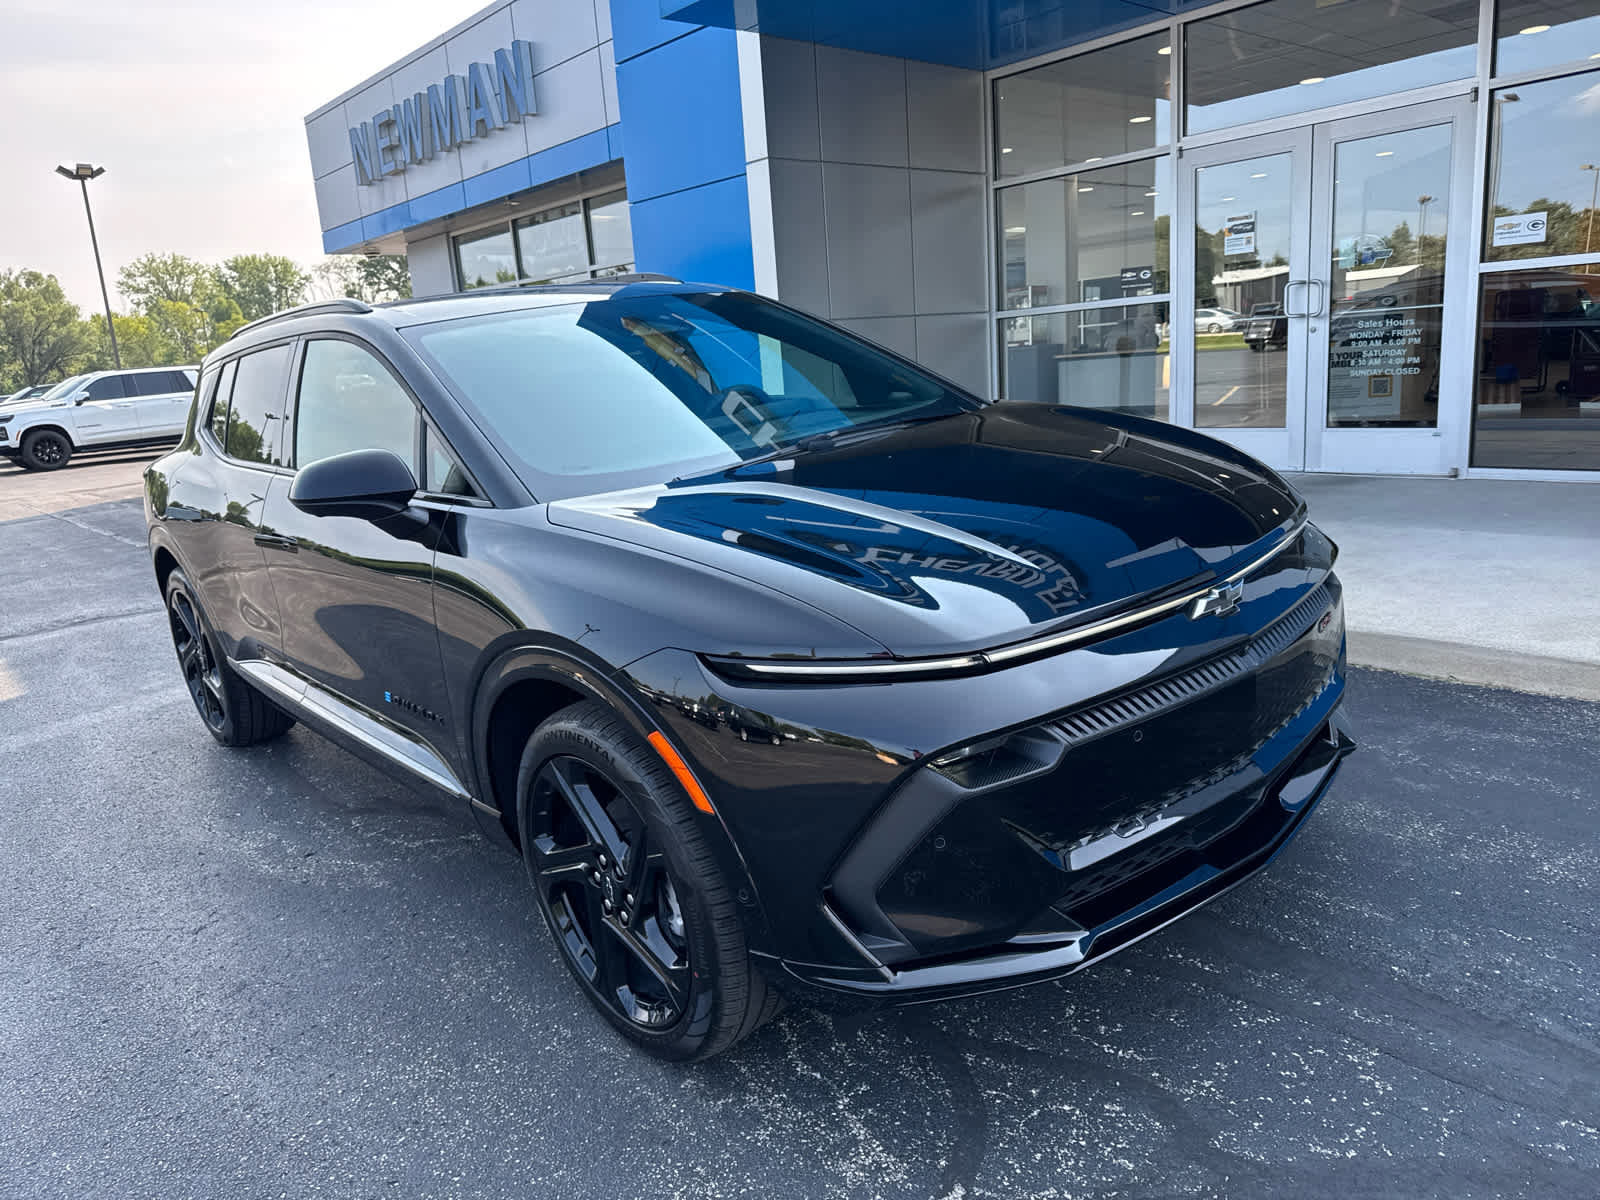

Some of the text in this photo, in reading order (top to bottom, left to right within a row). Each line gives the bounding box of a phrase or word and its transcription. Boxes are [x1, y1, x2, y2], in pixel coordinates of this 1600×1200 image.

[350, 40, 537, 185] NEWMAN
[1358, 318, 1416, 328] Sales Hours
[1349, 330, 1384, 339] MONDAY
[1391, 328, 1423, 337] FRIDAY
[1369, 339, 1382, 347] AM
[1336, 352, 1363, 360] YOUR
[1362, 349, 1407, 358] SATURDAY
[1368, 358, 1381, 366] AM
[1407, 356, 1420, 364] PM
[1350, 367, 1420, 377] SUNDAY CLOSED
